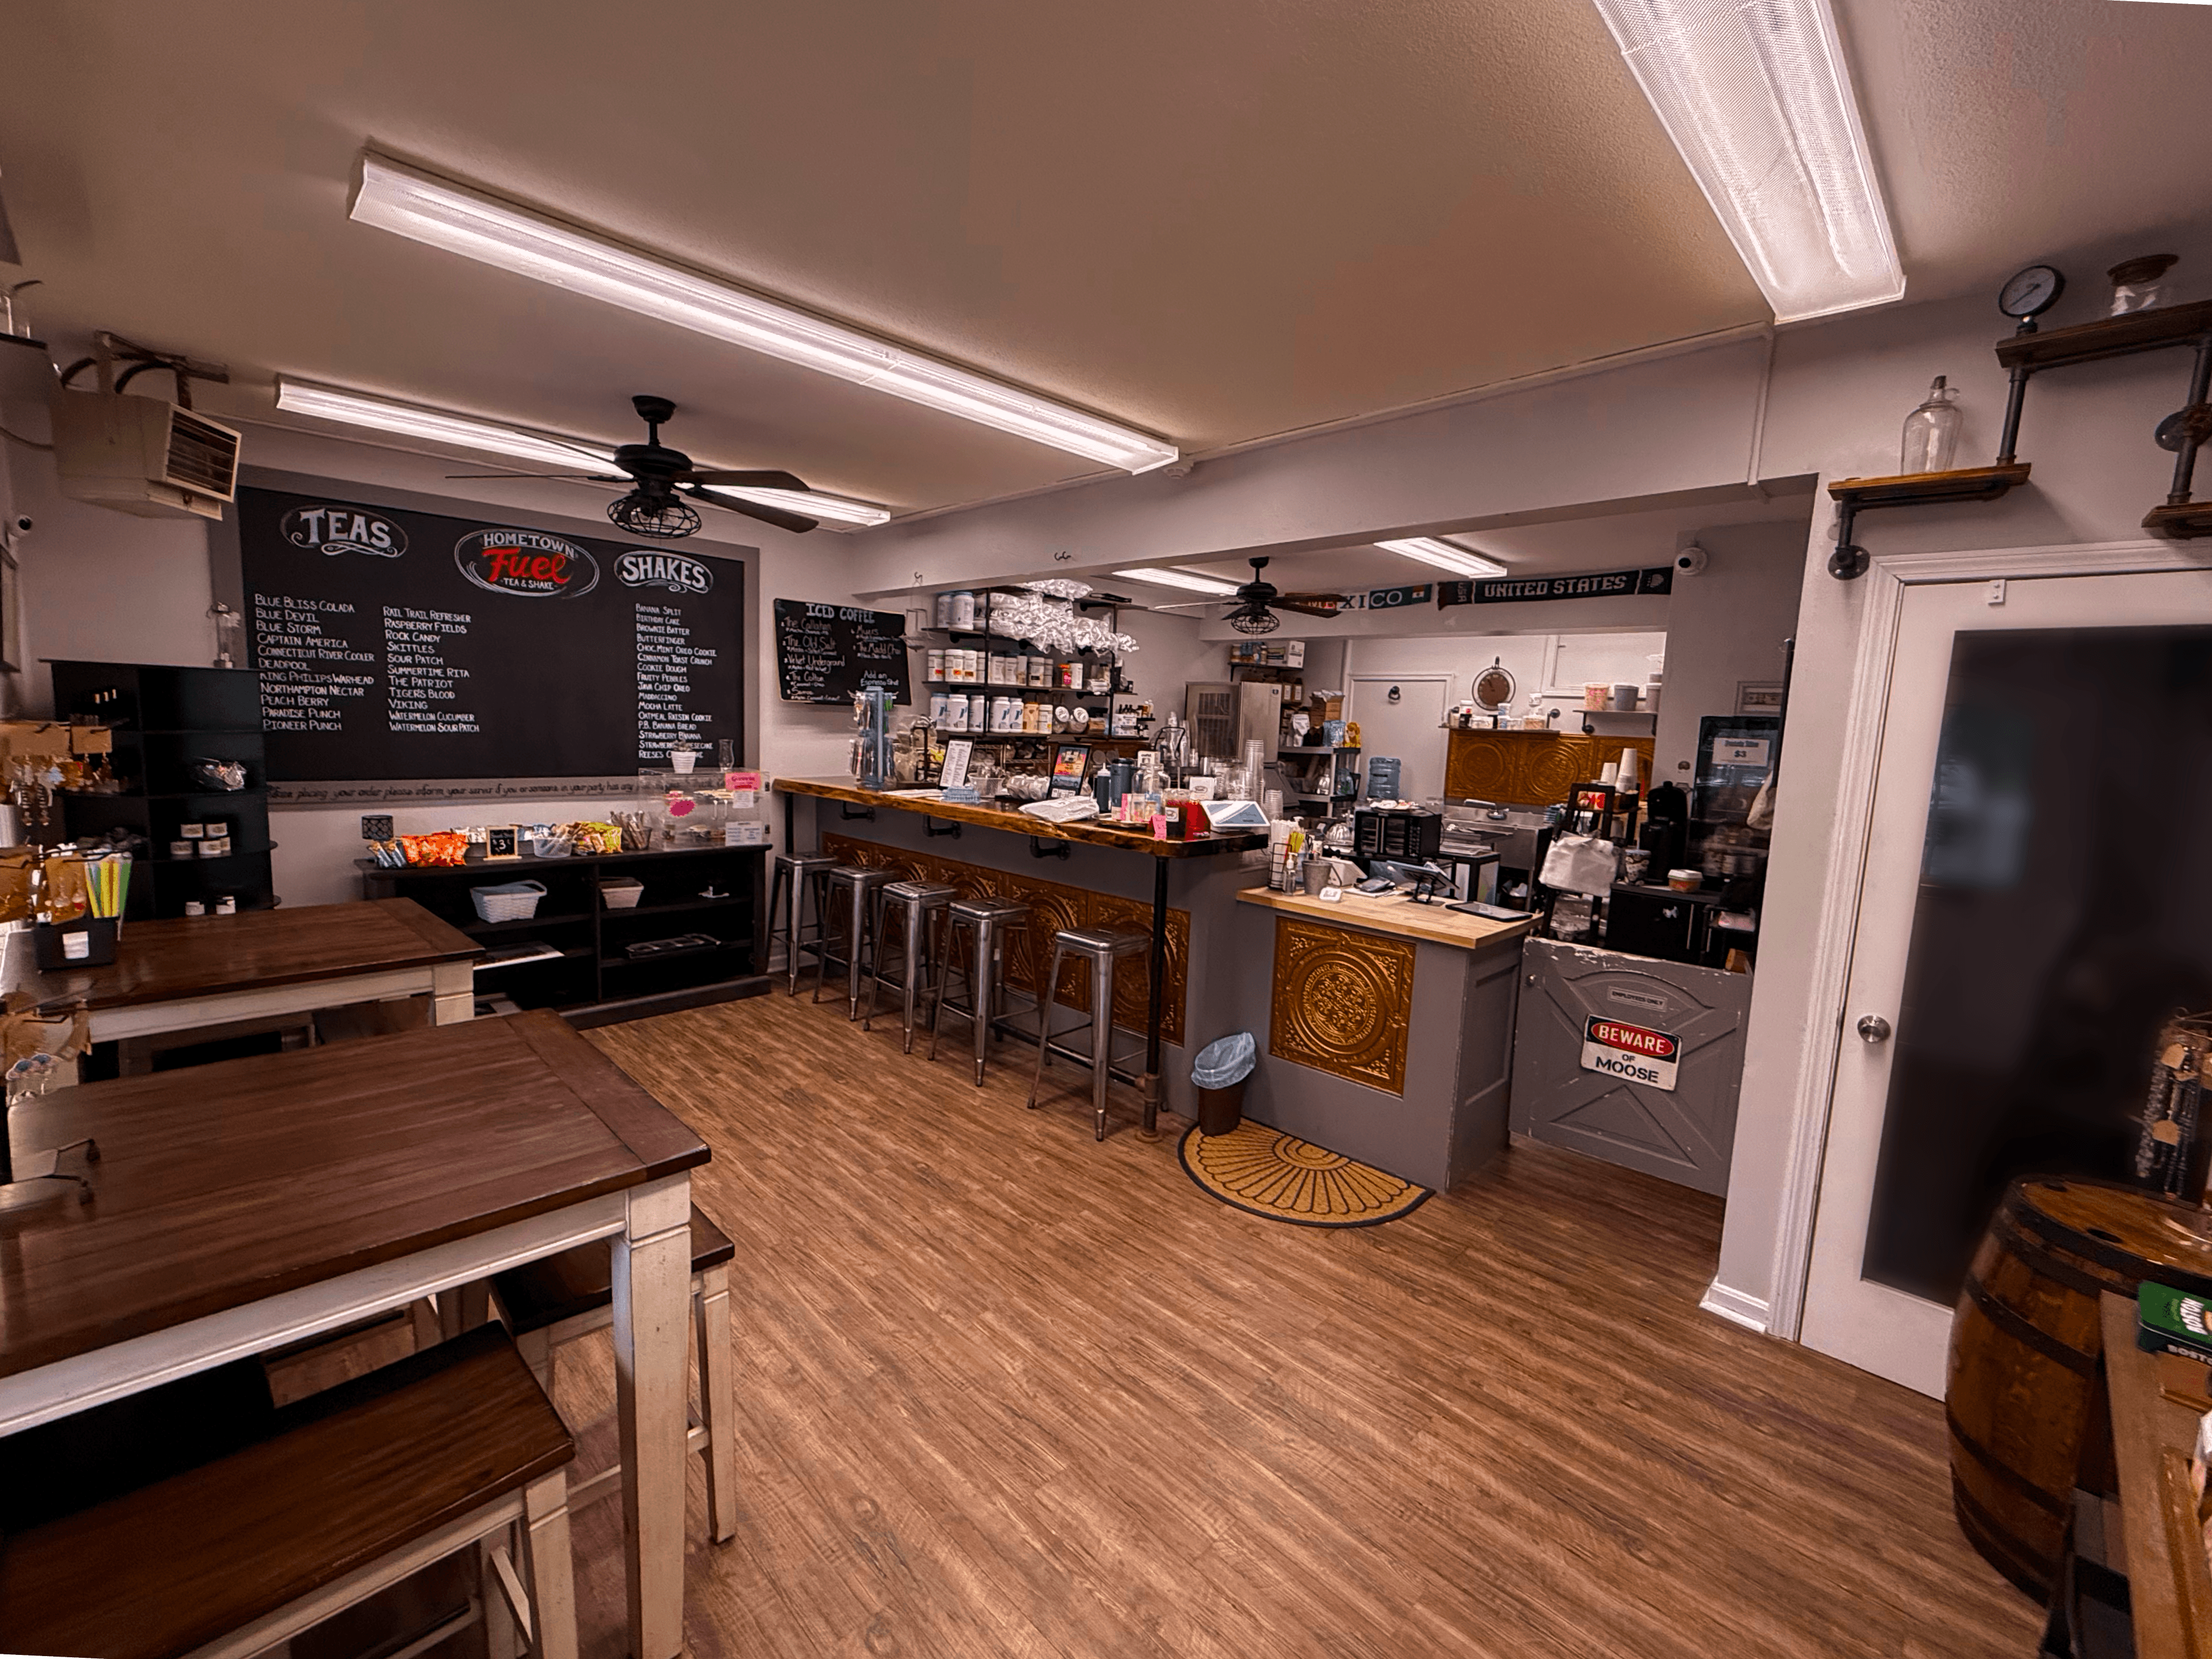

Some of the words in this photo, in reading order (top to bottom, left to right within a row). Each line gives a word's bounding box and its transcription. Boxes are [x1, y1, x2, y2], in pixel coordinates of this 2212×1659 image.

[299, 508, 391, 548] TEAS
[484, 533, 574, 558] HOMETOWN
[482, 547, 571, 584] Fuel
[622, 556, 705, 588] SHAKES
[504, 578, 519, 587] TEA
[529, 581, 554, 589] SHAKE
[1484, 582, 1548, 597] UNITED
[1553, 576, 1627, 594] STATES
[1458, 583, 1467, 602] USA
[255, 593, 282, 607] BLUE
[283, 596, 317, 610] BLISS
[319, 600, 355, 613] COLADA
[256, 607, 283, 620] BLUE
[285, 610, 319, 622] DEVIL
[383, 606, 403, 617] RAIL
[404, 608, 429, 620] TRAIL
[430, 610, 471, 623] REFRESHER
[636, 603, 661, 614] BANANA
[662, 606, 681, 616] SPLIT
[806, 603, 834, 618] ICED
[840, 608, 875, 624] COFFEE
[384, 618, 433, 631] RASPBERRY
[434, 622, 467, 633] FIELDS
[665, 617, 680, 625] CAKE
[256, 620, 283, 632] BLUE
[287, 622, 321, 635] STORM
[636, 623, 665, 633] BROWNIE
[667, 626, 690, 636] BATTER
[257, 633, 302, 646] CAPTAIN
[305, 636, 348, 648] AMERICA
[385, 629, 410, 640] ROCK
[412, 632, 441, 643] CANDY
[636, 633, 685, 645] BUTTERFINGER
[258, 645, 316, 658] CONNECTICUT
[319, 648, 343, 659] RIVER
[345, 651, 375, 662] COOLER
[387, 642, 435, 654] SKITTLES
[675, 646, 693, 655] OREO
[694, 647, 717, 657] COOKIE
[259, 658, 311, 670] DEADPOOL
[387, 653, 412, 663] SOUR
[415, 655, 444, 665] PATCH
[637, 652, 669, 662] CINNAMON
[670, 654, 688, 664] TOAST
[690, 656, 713, 665] CRUNCH
[387, 664, 444, 676] SUMMERTIME
[447, 668, 470, 677] RITA
[637, 662, 663, 672] COOKIE
[665, 665, 687, 673] DOUGH
[333, 673, 374, 685] WARHEAD
[388, 675, 408, 686] THE
[412, 677, 454, 688] PATRIOT
[637, 672, 660, 681] FRUITY
[662, 673, 688, 683] PEBBLES
[260, 683, 327, 695] NORTHAMPTON
[329, 685, 364, 696] NECTAR
[637, 681, 652, 690] JAVA
[654, 683, 672, 691] CHIP
[673, 684, 690, 692] OREO
[261, 694, 294, 705] PEACH
[297, 696, 329, 706] BERRY
[428, 690, 455, 699] BLOOD
[388, 698, 428, 709] VIKING
[638, 702, 662, 710] MOCHA
[663, 703, 683, 711] LATTE
[263, 706, 306, 718] PARADISE
[308, 708, 341, 718] PUNCH
[388, 710, 436, 721] WATERMELON
[437, 711, 475, 721] CUCUMBER
[638, 711, 666, 721] OATMEAL
[668, 713, 690, 721] RAISIN
[691, 713, 712, 721] COOKIE
[263, 719, 307, 731] PIONEER
[309, 720, 342, 731] PUNCH
[389, 721, 436, 732] WATERMELON
[437, 722, 458, 732] SOUR
[459, 723, 480, 732] PATCH
[652, 721, 676, 730] BANANA
[639, 731, 677, 739] STRAWBERRY
[639, 740, 674, 749] STRAWBERR
[639, 750, 664, 758] REESES
[1598, 1024, 1665, 1053] BEWARE
[1622, 1054, 1636, 1063] OF
[1595, 1056, 1659, 1083] MOOSE
[2180, 1296, 2209, 1336] BOSTON
